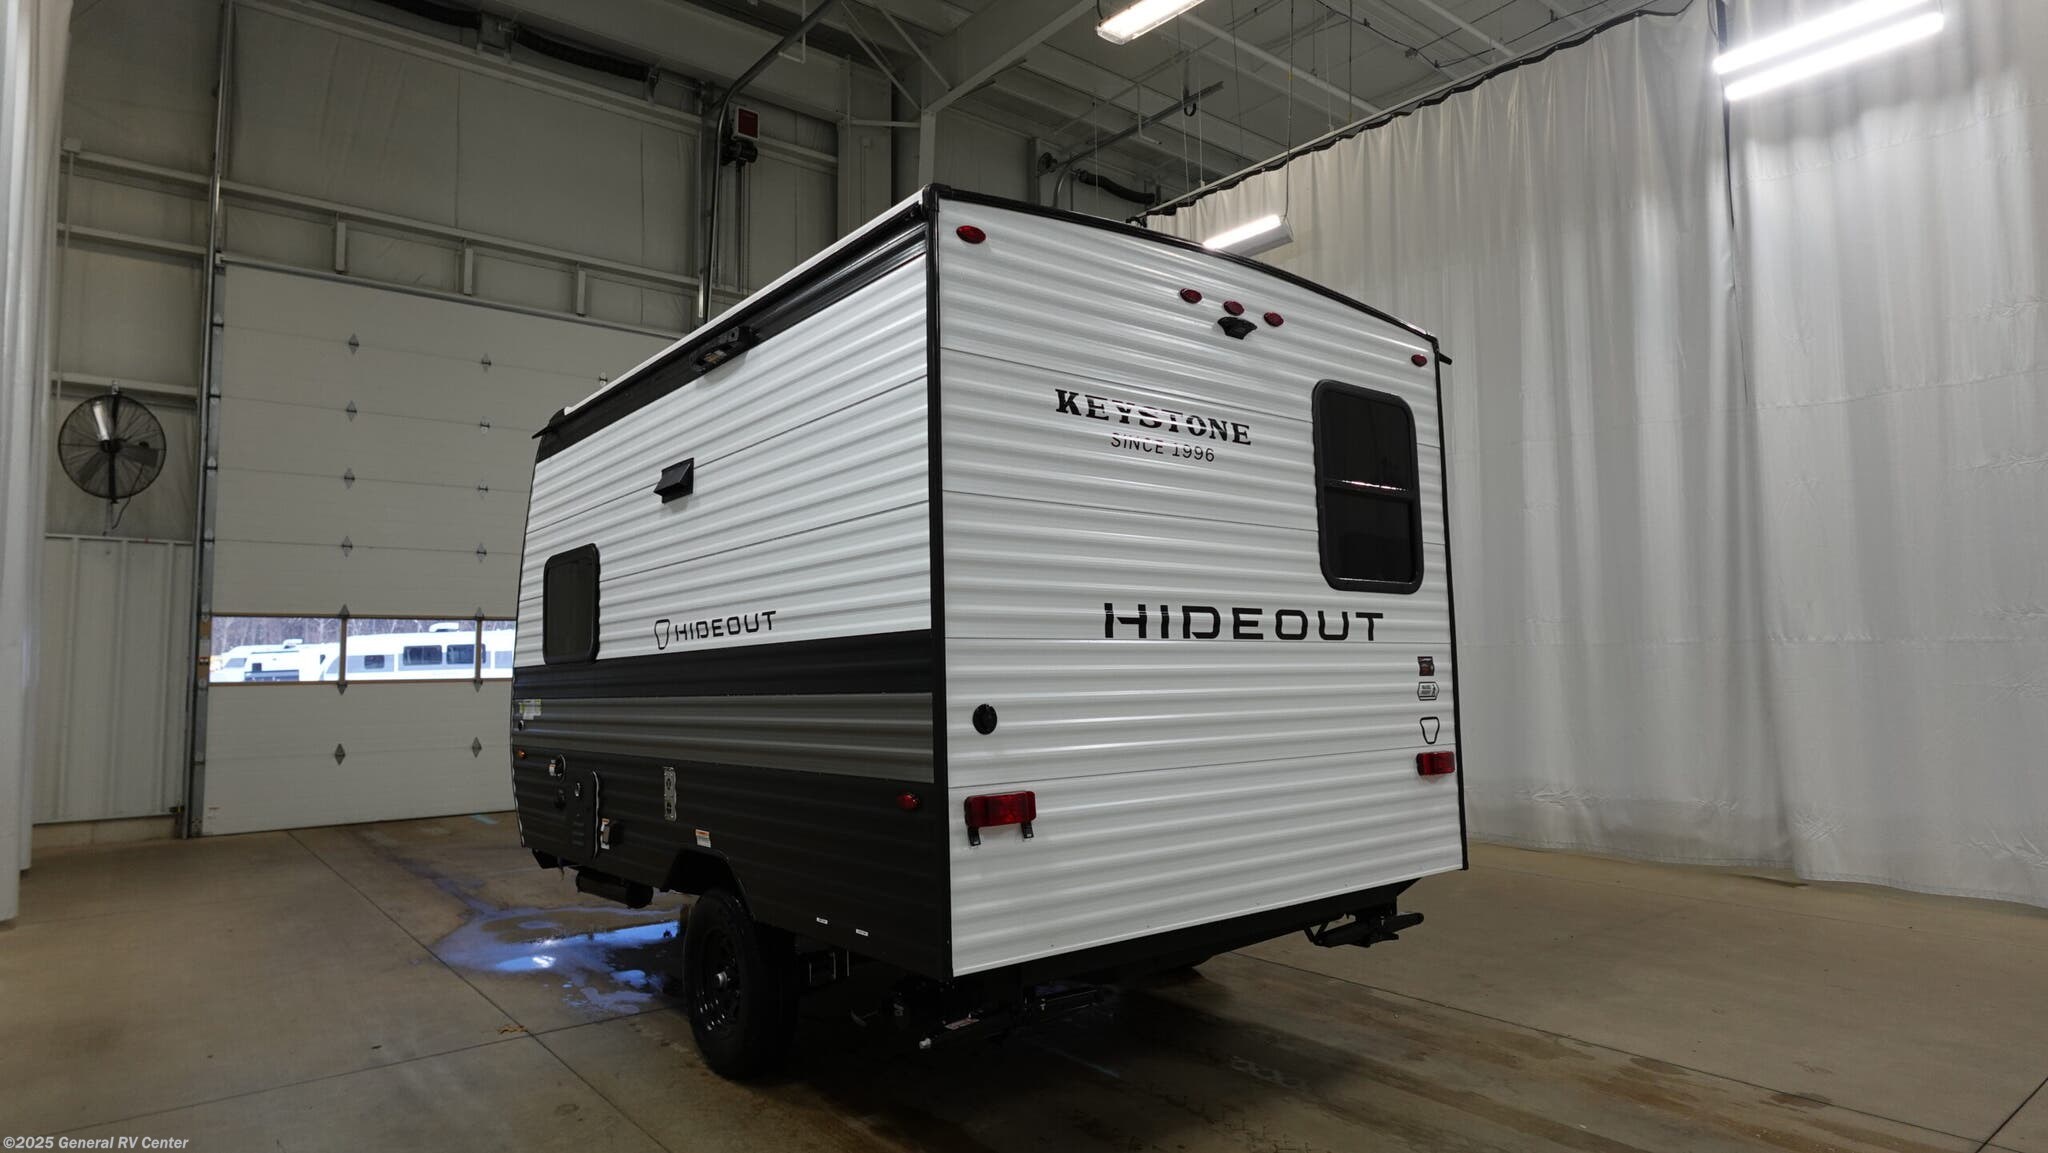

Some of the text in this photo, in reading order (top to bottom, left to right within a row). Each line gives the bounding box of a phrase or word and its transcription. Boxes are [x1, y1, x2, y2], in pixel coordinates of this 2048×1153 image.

[1055, 388, 1251, 446] KEYSTONE
[1111, 432, 1215, 462] SINCE 1996
[675, 610, 777, 642] HIDEOUT
[1104, 602, 1384, 641] HIDEOUT
